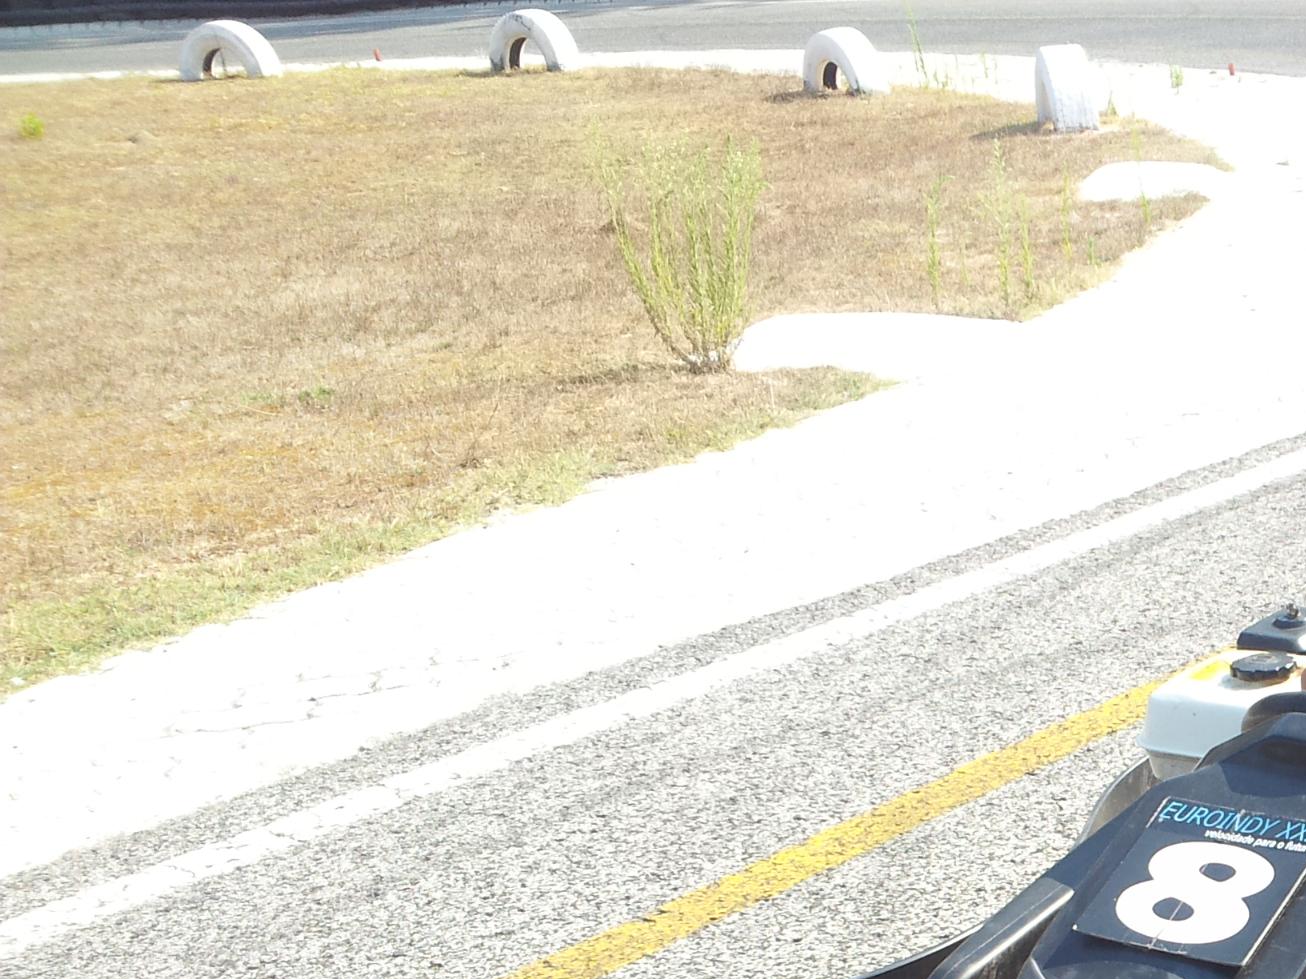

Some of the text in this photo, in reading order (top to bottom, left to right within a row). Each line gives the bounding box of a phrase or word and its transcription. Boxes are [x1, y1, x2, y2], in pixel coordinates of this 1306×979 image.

[1159, 801, 1281, 836] EUROINDY
[1204, 829, 1256, 845] velocidade
[1252, 837, 1279, 849] para
[1115, 841, 1275, 945] 8
